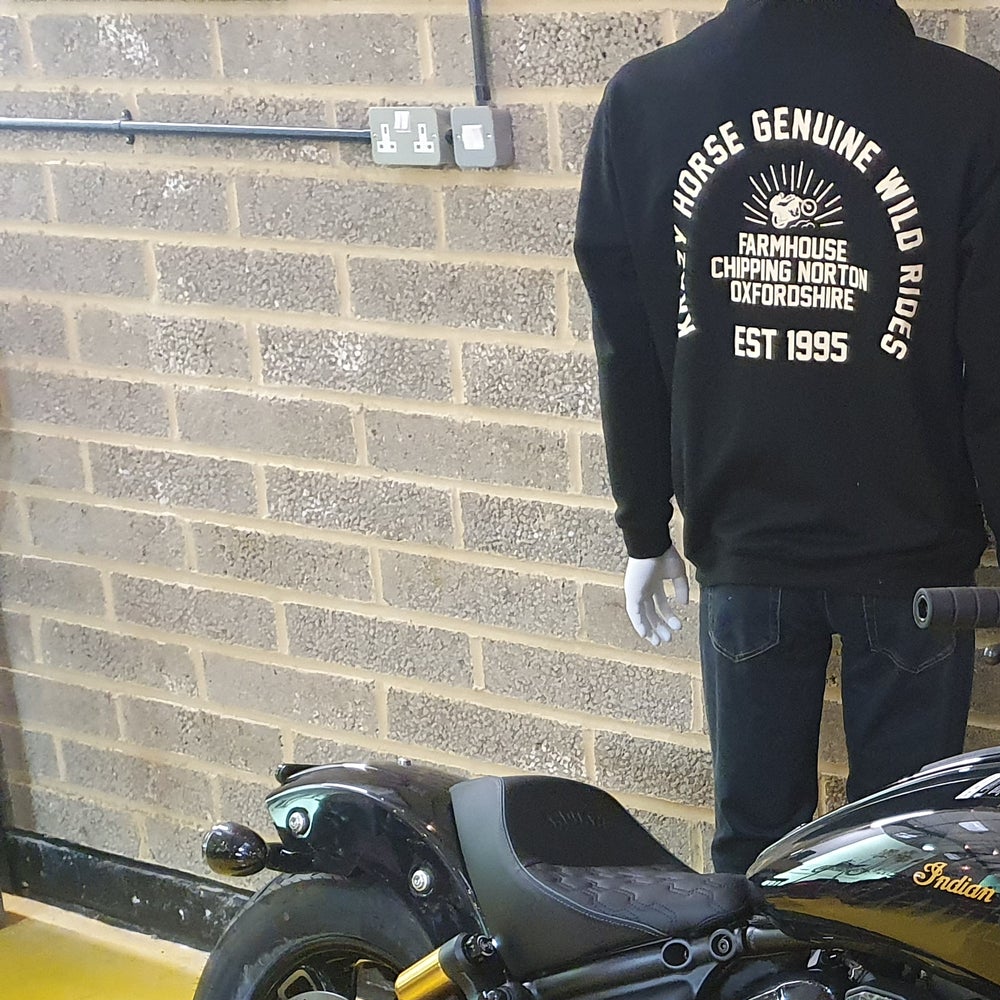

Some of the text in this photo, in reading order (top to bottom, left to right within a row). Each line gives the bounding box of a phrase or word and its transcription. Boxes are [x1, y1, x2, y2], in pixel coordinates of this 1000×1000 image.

[752, 106, 882, 174] GENUINE
[673, 121, 745, 219] HORSE
[874, 166, 923, 252] WILD
[738, 232, 848, 262] FARMHOUSE
[710, 256, 868, 292] CHIPPING NORTON
[730, 280, 854, 311] OXFORDSHIRE
[880, 264, 924, 360] RIDES
[734, 325, 848, 363] EST 1995
[913, 861, 996, 903] Indian
